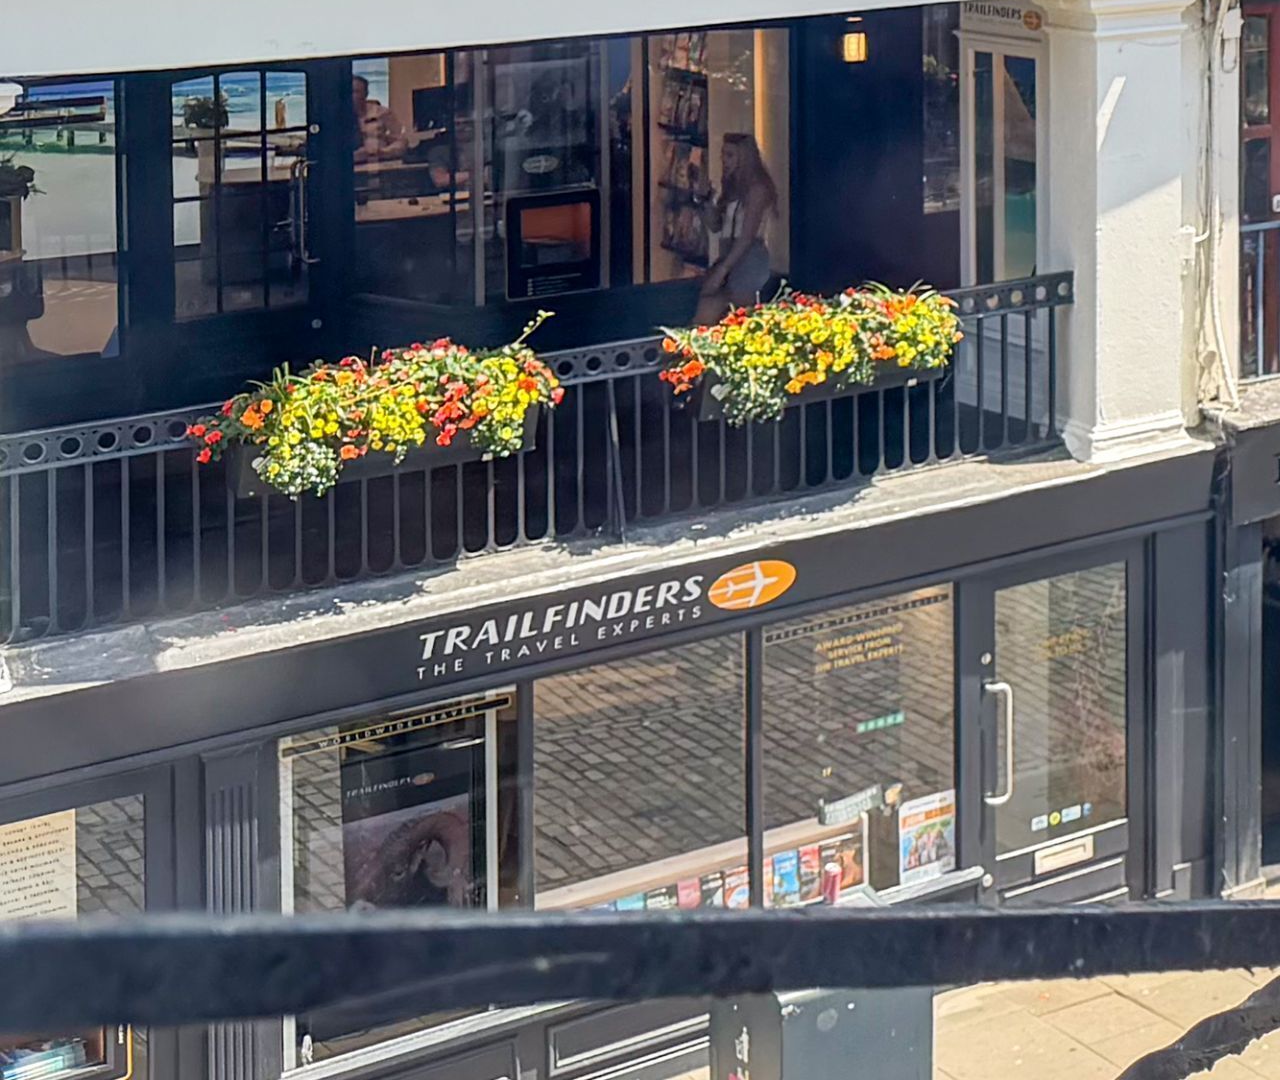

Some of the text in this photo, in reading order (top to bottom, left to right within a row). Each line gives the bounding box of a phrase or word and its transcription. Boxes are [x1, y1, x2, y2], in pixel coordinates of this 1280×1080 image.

[964, 2, 1022, 20] TRAILFINDERS
[417, 605, 702, 680] THE TRAVEL EXPERTS
[419, 575, 704, 660] TRAILFINDERS
[318, 719, 414, 749] WORLDWIDE
